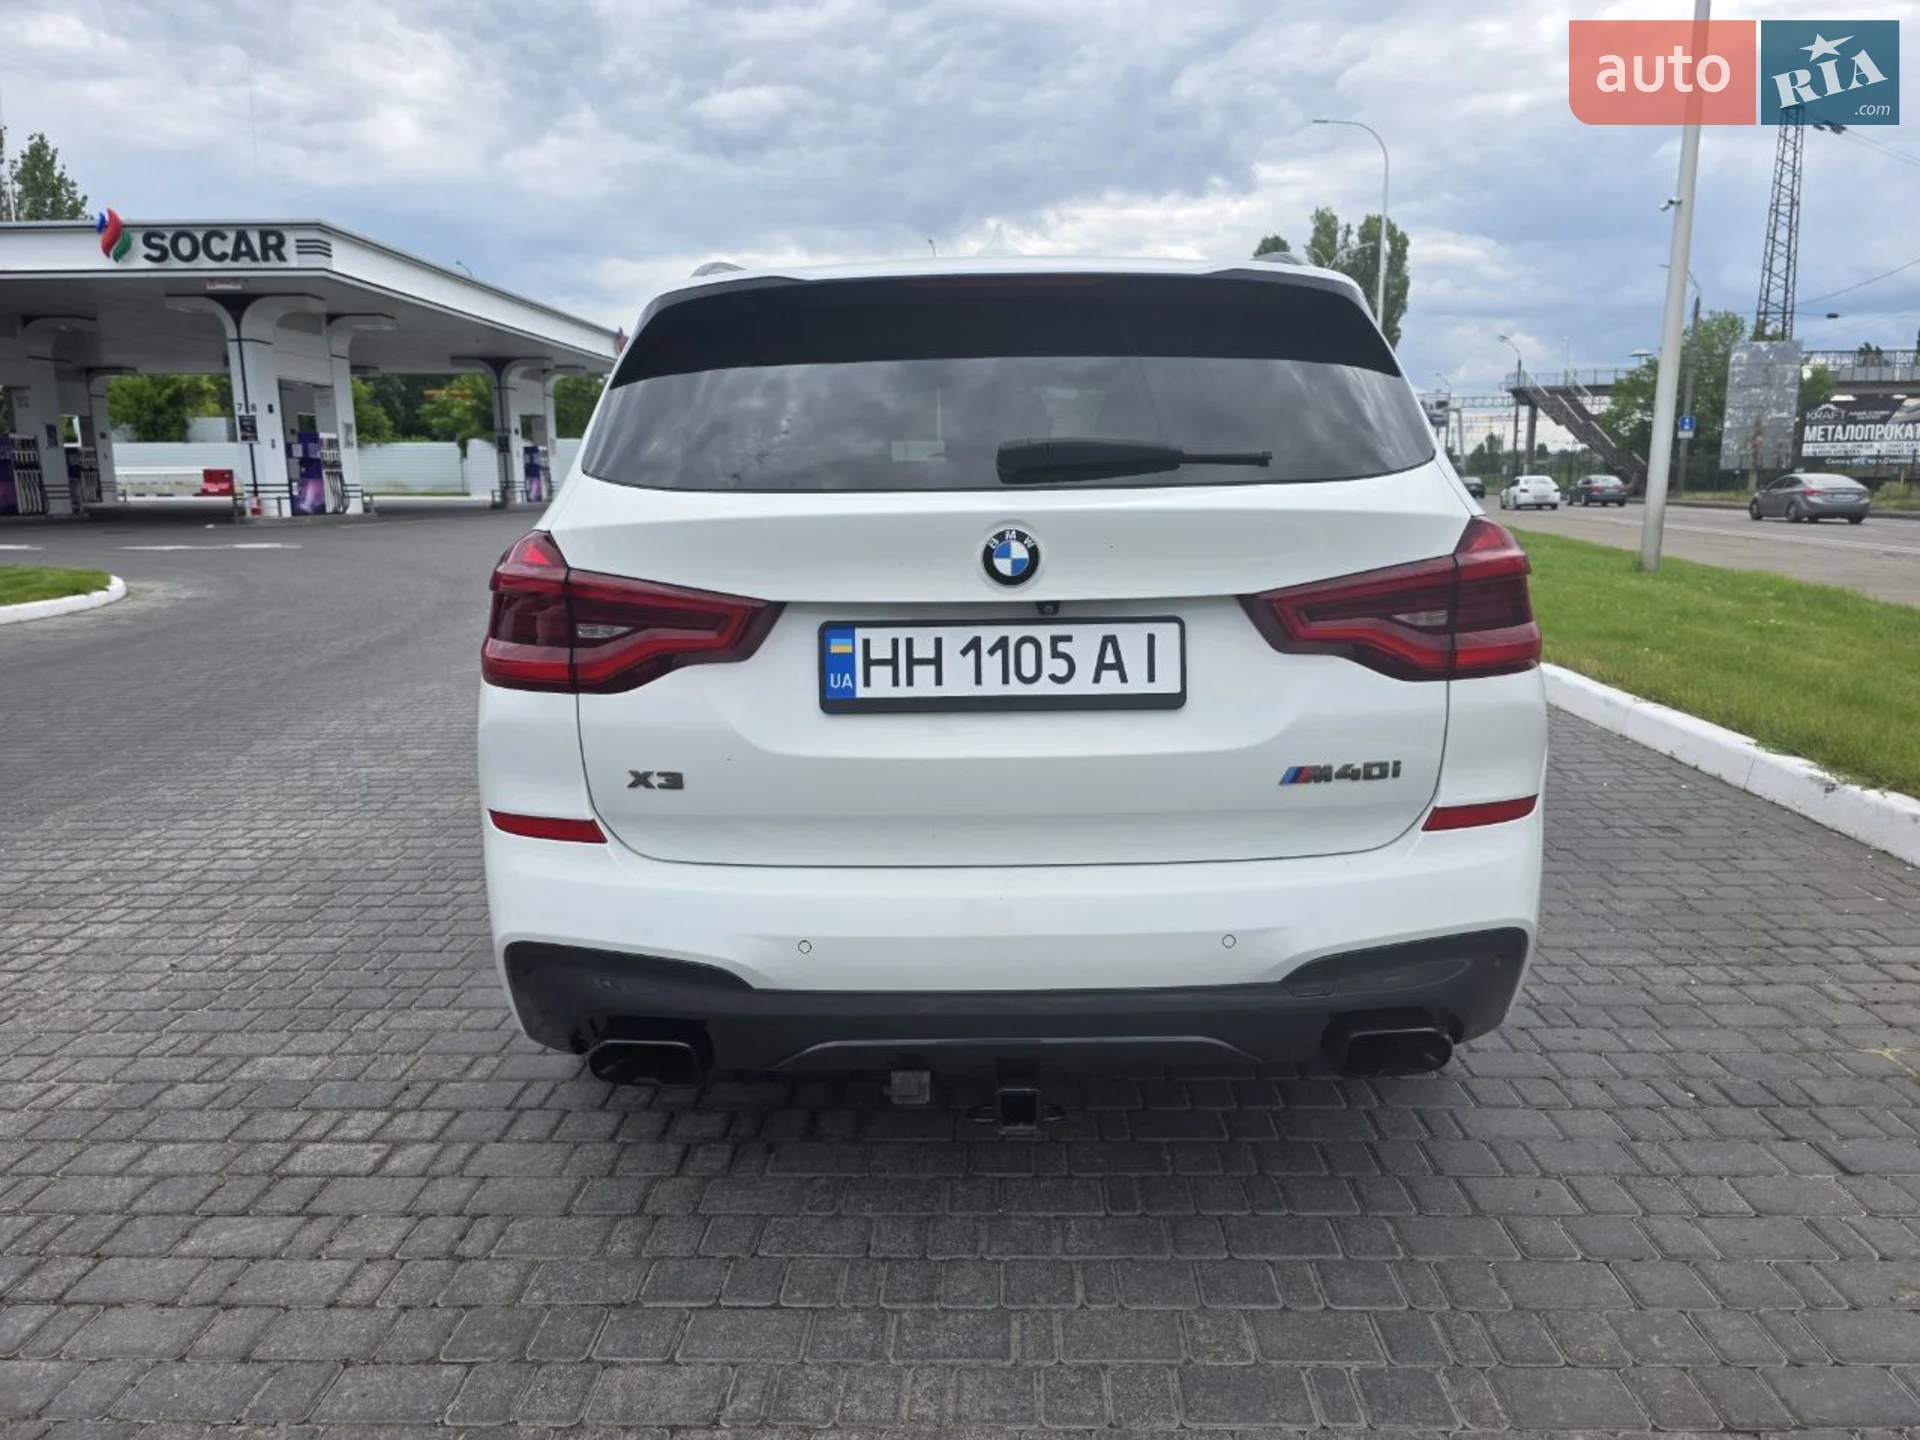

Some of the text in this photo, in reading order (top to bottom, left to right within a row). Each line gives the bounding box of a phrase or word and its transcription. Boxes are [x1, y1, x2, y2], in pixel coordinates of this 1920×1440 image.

[142, 229, 287, 264] SOCAR
[1806, 410, 1846, 420] KRAFT
[987, 530, 1036, 550] BMW
[862, 636, 943, 688] HH
[959, 634, 1077, 686] 1105
[829, 673, 854, 689] UA
[626, 770, 684, 789] X3
[1298, 760, 1402, 784] M40i
